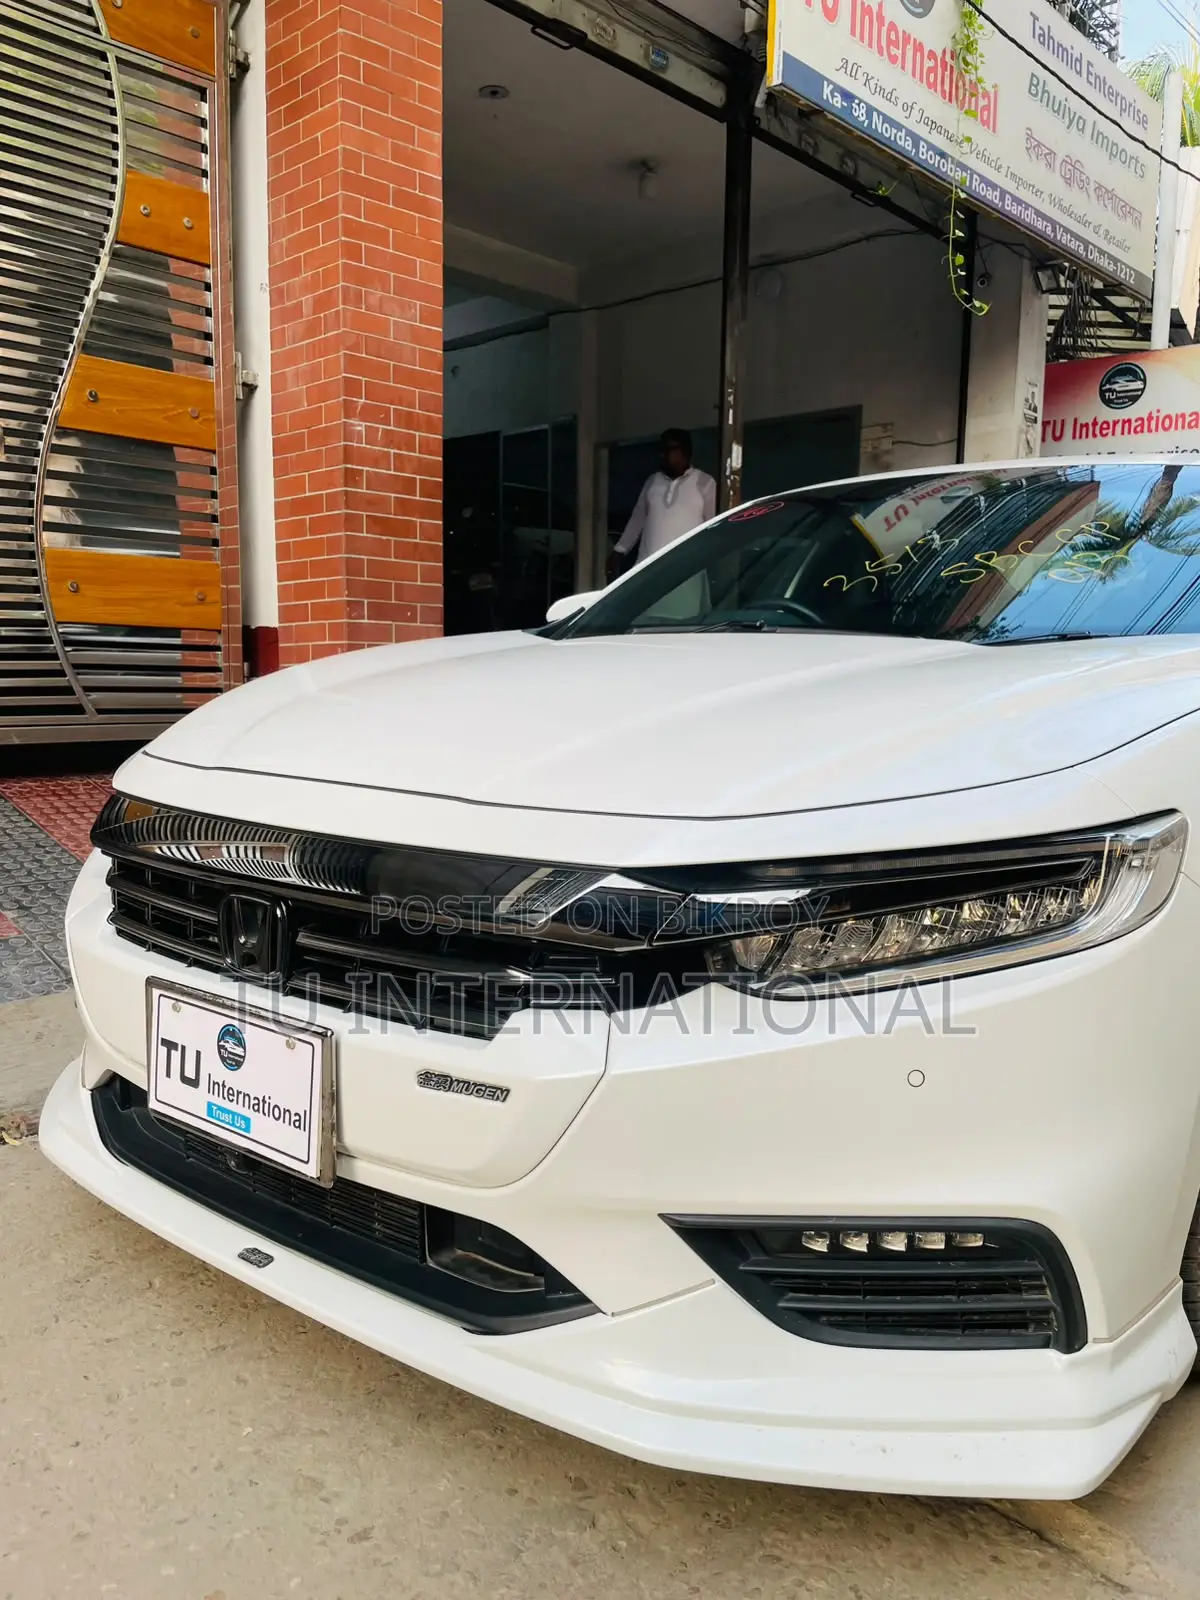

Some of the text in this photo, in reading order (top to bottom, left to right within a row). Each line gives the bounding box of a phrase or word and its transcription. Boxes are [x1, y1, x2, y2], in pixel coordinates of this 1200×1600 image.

[1030, 11, 1149, 131] Tahmid Enterprise
[835, 57, 861, 81] All
[862, 72, 900, 107] Kinds
[902, 101, 917, 119] of
[968, 141, 1002, 173] Vehicle
[1005, 165, 1045, 203] Importer,
[1048, 193, 1092, 229] Wholesaler
[1102, 229, 1132, 254] Retailer
[1027, 72, 1147, 179] Bhuiya Imports
[823, 80, 848, 109] Ka-
[872, 111, 916, 155] Norda,
[971, 174, 1003, 208] Road,
[1004, 193, 1054, 239] Baridhara,
[1055, 224, 1086, 257] Vatara,
[1088, 245, 1135, 284] Dhaka-1212
[1041, 418, 1065, 442] TU
[160, 1037, 307, 1133] TU International
[211, 1105, 246, 1129] Trust Us
[450, 1078, 510, 1102] MUGEN
